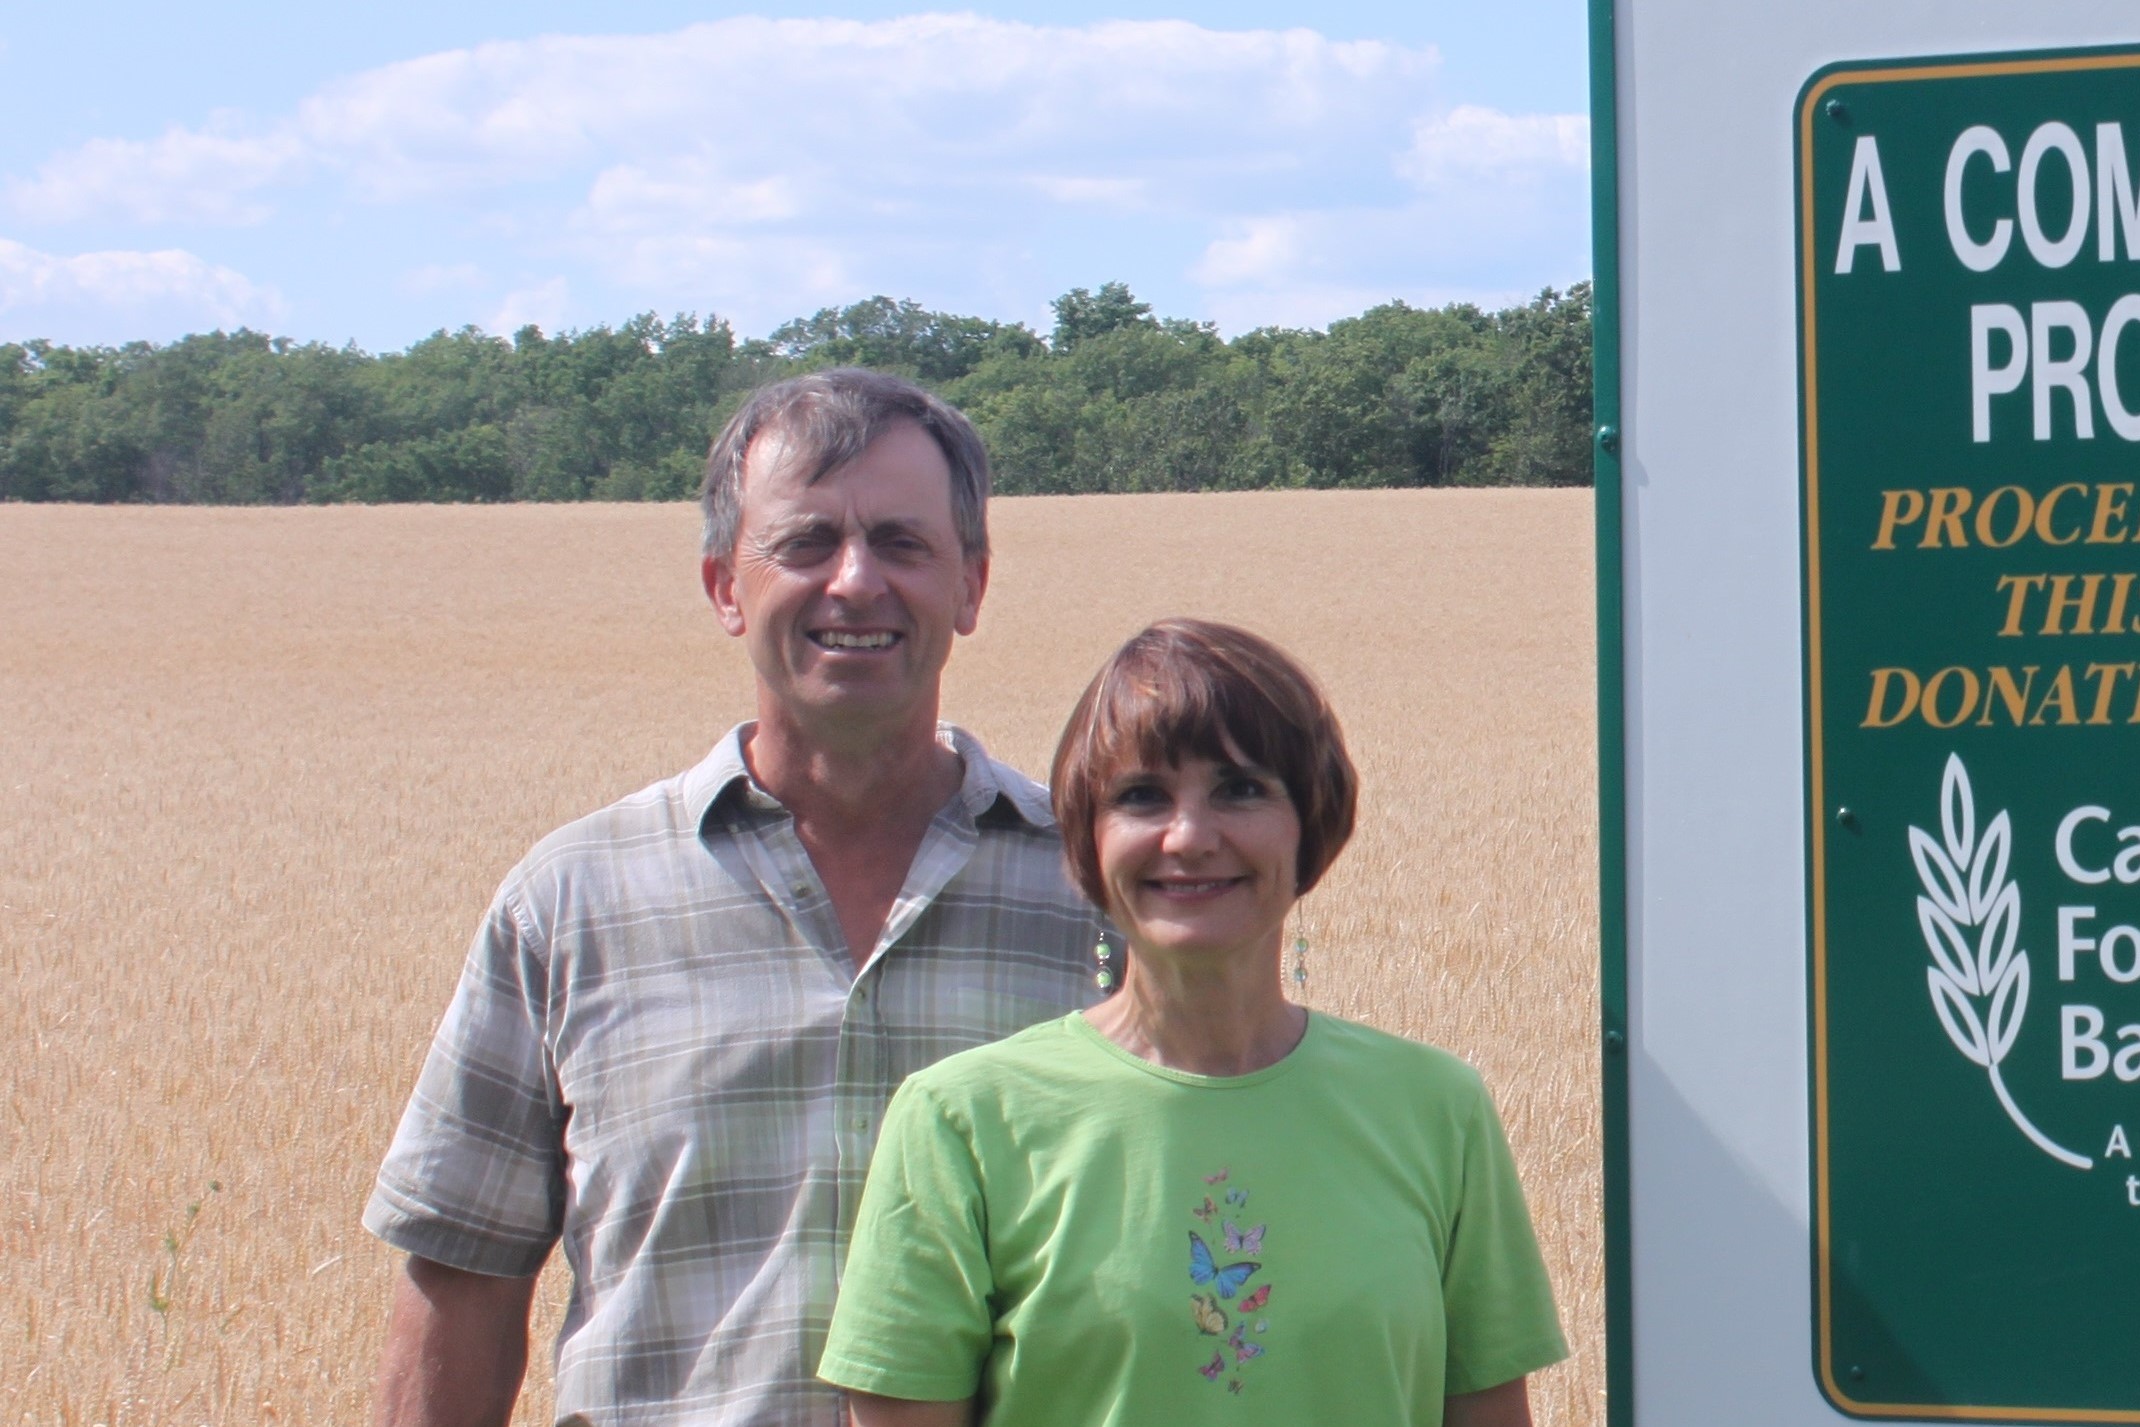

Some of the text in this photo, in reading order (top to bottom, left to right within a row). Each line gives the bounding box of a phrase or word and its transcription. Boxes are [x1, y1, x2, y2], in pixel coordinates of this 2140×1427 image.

[1834, 135, 1902, 275] A
[1869, 483, 2140, 550] PROCE
[2057, 905, 2140, 983] Fo
[2104, 1124, 2132, 1158] A
